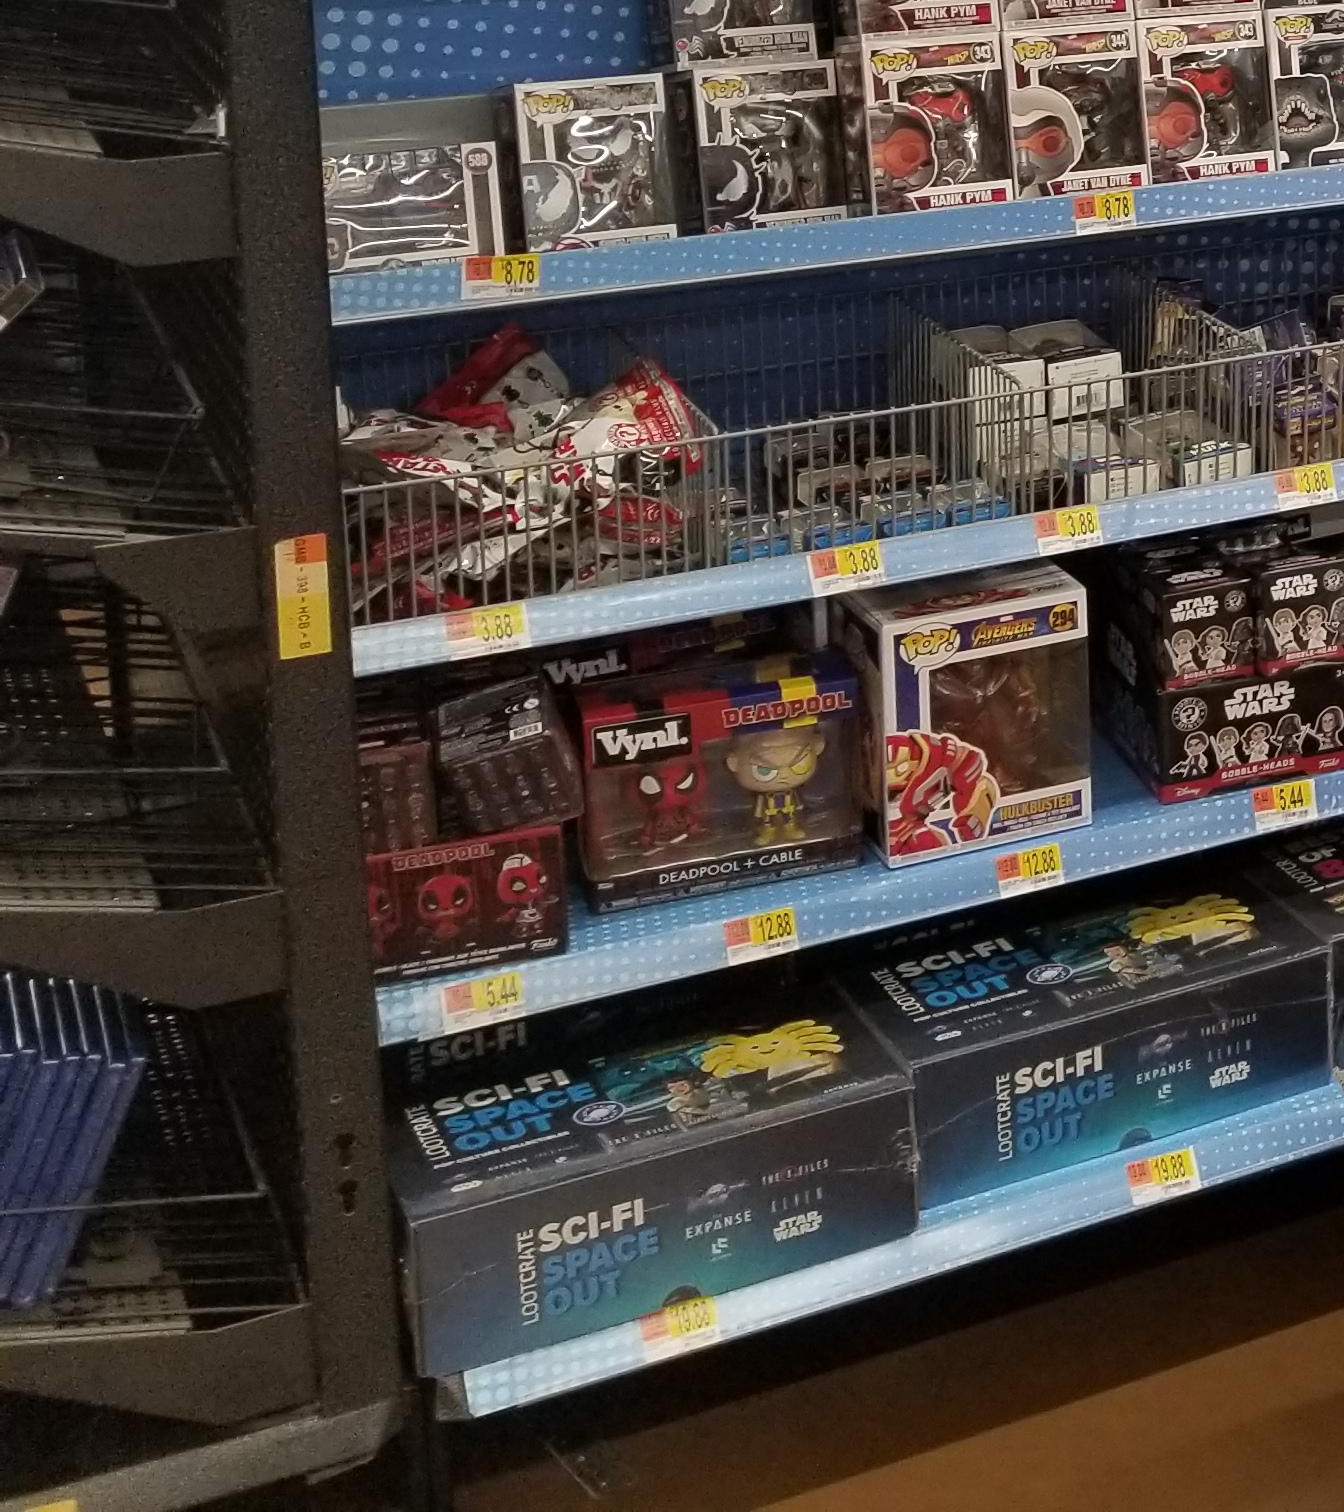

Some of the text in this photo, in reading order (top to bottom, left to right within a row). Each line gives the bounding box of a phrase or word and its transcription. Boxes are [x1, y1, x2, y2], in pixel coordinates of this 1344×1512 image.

[915, 4, 977, 20] HANK PYM
[1200, 161, 1256, 176] HANK PYM
[929, 190, 993, 207] HANK PYM
[1105, 197, 1130, 219] 8.78
[505, 260, 536, 283] 8.78
[1303, 469, 1329, 493] 3.88
[1069, 514, 1096, 536] 3.88
[849, 551, 880, 574] 3.88
[1270, 573, 1318, 591] STAR
[1271, 582, 1318, 601] WARS
[1170, 594, 1219, 611] STAR
[1170, 605, 1219, 623] WARS
[481, 614, 514, 641] 3.88
[901, 626, 960, 661] POP!
[1051, 605, 1076, 629] 294
[1226, 680, 1296, 705] STAR
[722, 691, 853, 728] DEADPOOL
[1224, 695, 1295, 721] WARS
[597, 721, 689, 761] Vynl.
[1002, 793, 1073, 820] HULKBUSTER
[1279, 790, 1304, 810] 5.44
[392, 842, 496, 871] DEADPOOL
[659, 860, 740, 885] DEADPOOL
[759, 849, 802, 867] CABLE
[759, 912, 792, 943] 12.88
[896, 938, 1014, 978] SCI-FI
[487, 980, 519, 1007] 5.44
[925, 974, 1010, 1009] OUT
[1014, 1046, 1103, 1095] SCI-FI
[1136, 1058, 1193, 1085] EXPANSE
[433, 1069, 570, 1117] SCI-FI
[1016, 1073, 1115, 1123] SPACE
[443, 1081, 598, 1134] SPACE
[995, 1072, 1013, 1162] LOOTCRATE
[453, 1111, 555, 1151] OUT
[1017, 1112, 1082, 1154] OUT
[1156, 1155, 1186, 1182] 19.88
[538, 1198, 645, 1252] SCI-FI
[685, 1209, 753, 1240] EXPANSE
[773, 1220, 823, 1243] WARS
[777, 1210, 823, 1231] STAR
[542, 1226, 660, 1281] SPACE
[517, 1226, 539, 1327] LOOTCRATE
[546, 1268, 621, 1317] OUT
